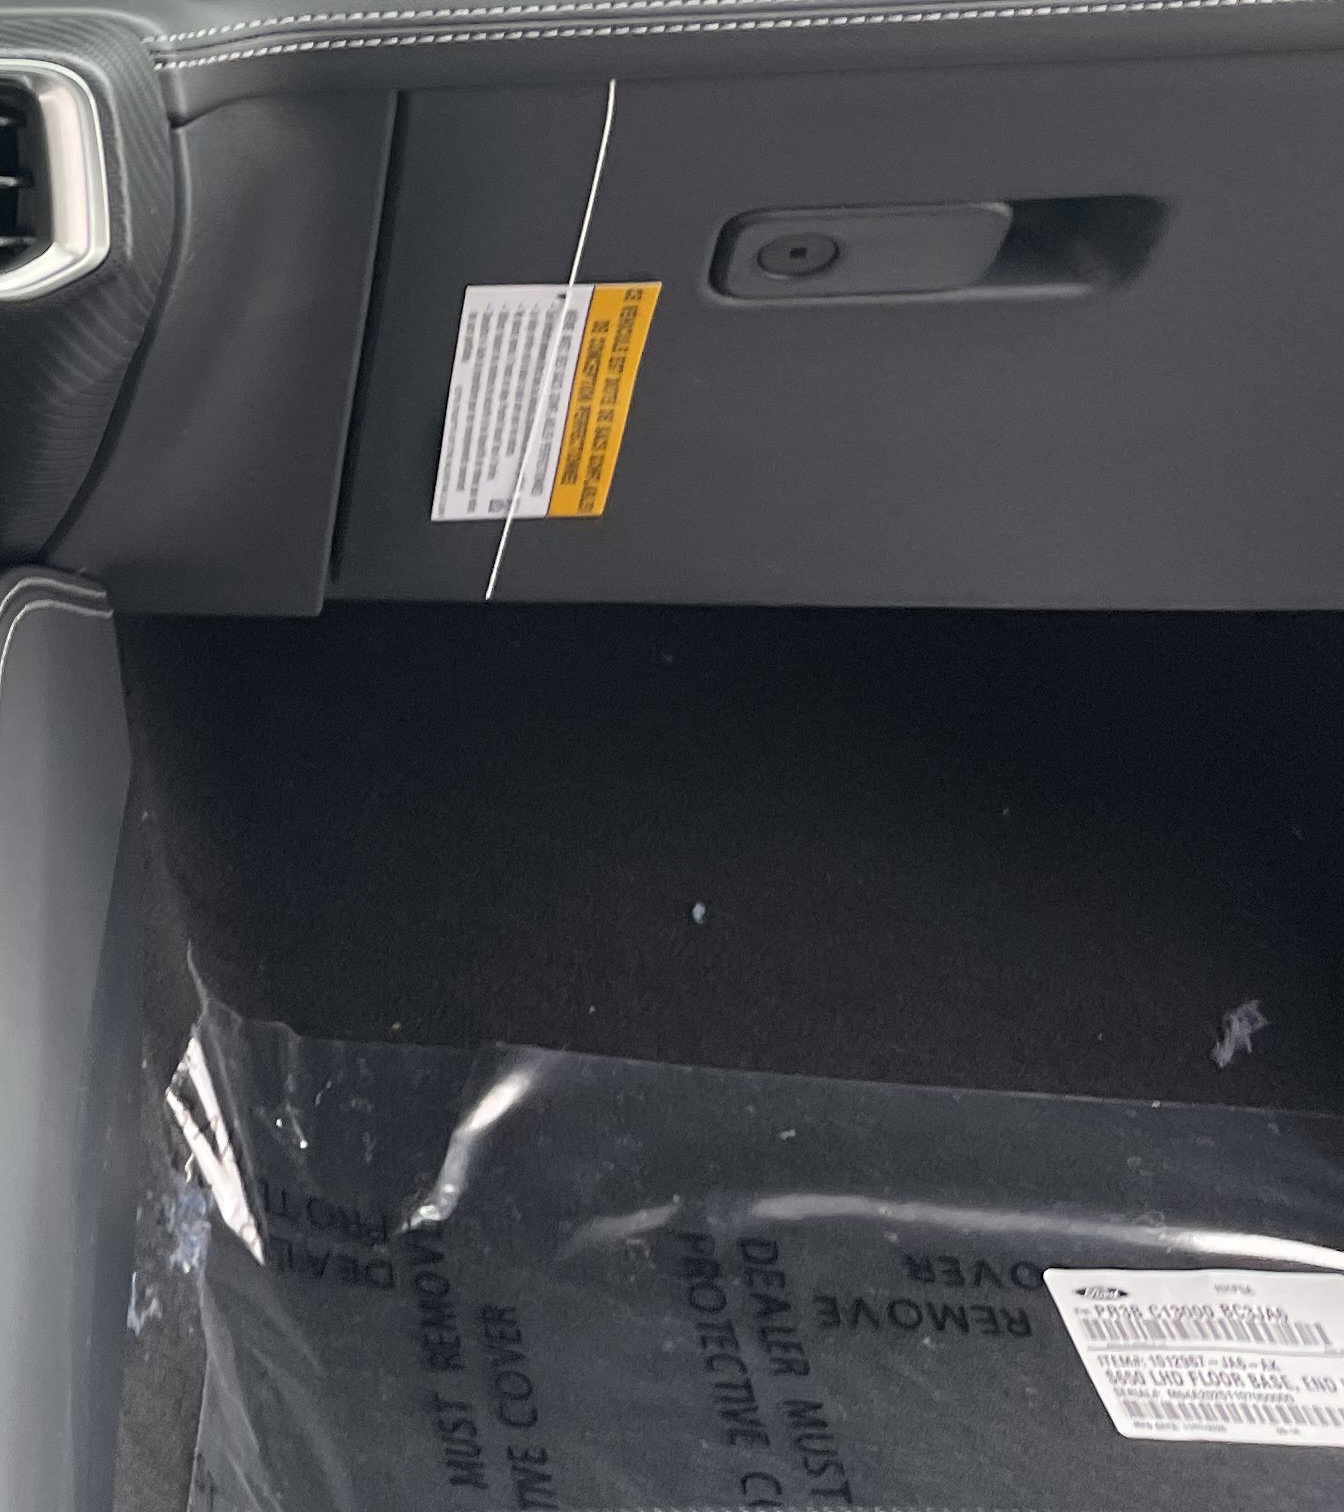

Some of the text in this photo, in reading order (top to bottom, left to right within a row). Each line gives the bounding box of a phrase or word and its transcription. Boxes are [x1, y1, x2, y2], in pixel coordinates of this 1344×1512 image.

[812, 1295, 1034, 1339] REMOVE
[904, 1252, 1047, 1291] OVER
[480, 1303, 540, 1429] COVER
[664, 1230, 772, 1449] PROTECTIVE
[735, 1235, 854, 1505] DEALER MUST
[432, 1391, 490, 1490] MUST
